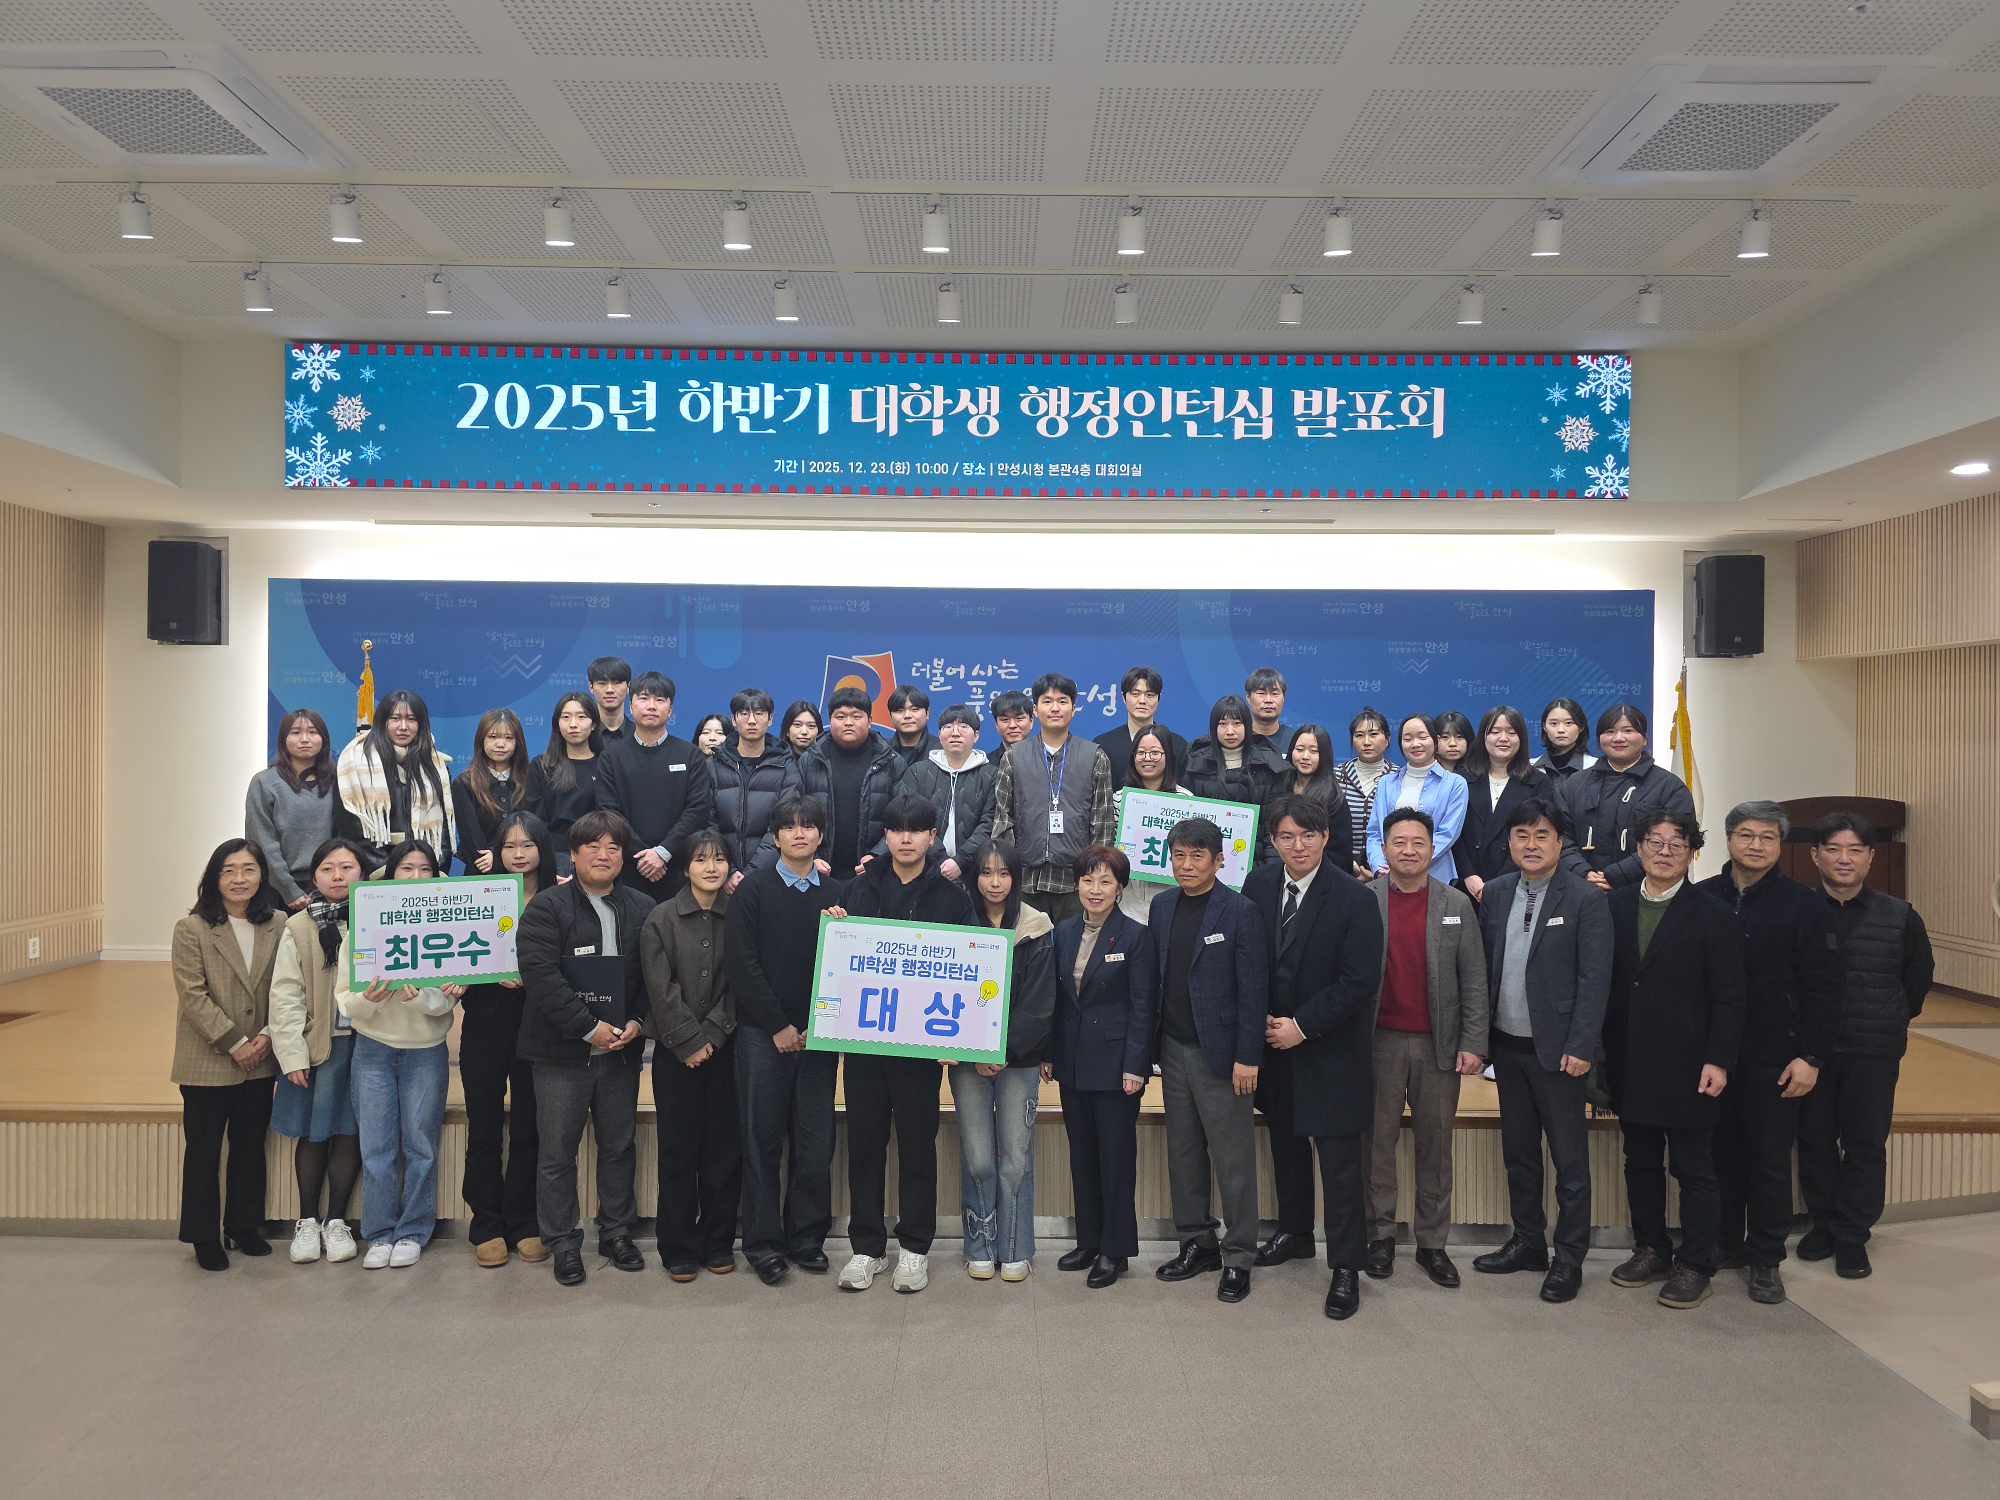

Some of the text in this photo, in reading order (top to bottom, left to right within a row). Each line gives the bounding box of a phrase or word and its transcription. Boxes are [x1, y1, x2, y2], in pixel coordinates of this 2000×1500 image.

[456, 379, 1445, 440] 2025년 하반기 대학생 행정인턴십 발표회
[774, 460, 798, 473] 기간
[809, 461, 843, 474] 2025.
[848, 461, 867, 474] 12.
[871, 461, 911, 476] 23.(화)
[915, 462, 949, 474] 10:00
[963, 462, 986, 476] 장소
[997, 463, 1044, 477] 안성시청
[1048, 463, 1091, 477] 본관4층
[1095, 463, 1142, 477] 대회의실
[322, 592, 346, 605] 안성
[586, 595, 610, 608] 안성
[846, 600, 870, 612] 안성
[1101, 602, 1125, 615] 안성
[1360, 602, 1383, 615] 안성
[1620, 605, 1644, 618] 안성
[1493, 608, 1512, 618] 안성
[390, 632, 414, 645] 안성
[653, 636, 677, 648] 안성
[1425, 642, 1449, 655] 안성
[322, 671, 346, 684] 안성
[911, 657, 1020, 692] 더불어 사는
[1357, 680, 1381, 693] 안성
[1617, 683, 1641, 696] 안성
[1142, 816, 1175, 831] 대학생
[402, 894, 473, 907] 2025년 하반기
[380, 905, 495, 926] 대학생 행정인턴십
[384, 930, 491, 971] 최우수
[875, 941, 956, 960] 2025년 하반기
[849, 955, 979, 982] 대학생 행정인턴십
[857, 987, 966, 1037] 대 상
